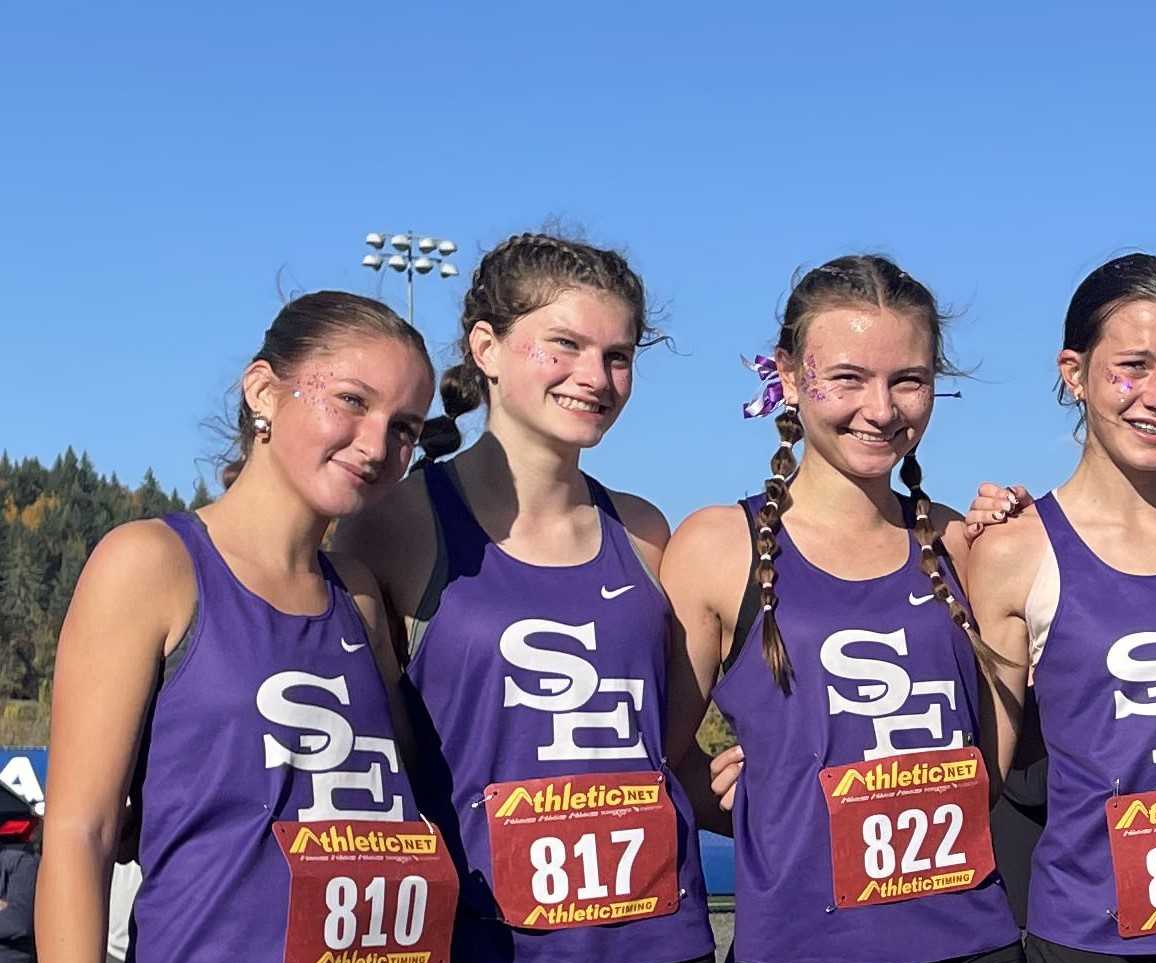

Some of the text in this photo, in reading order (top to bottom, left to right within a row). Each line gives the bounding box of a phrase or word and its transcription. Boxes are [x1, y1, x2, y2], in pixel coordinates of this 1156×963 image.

[529, 827, 645, 904] 817
[862, 803, 967, 879] 822
[324, 875, 428, 950] 810
